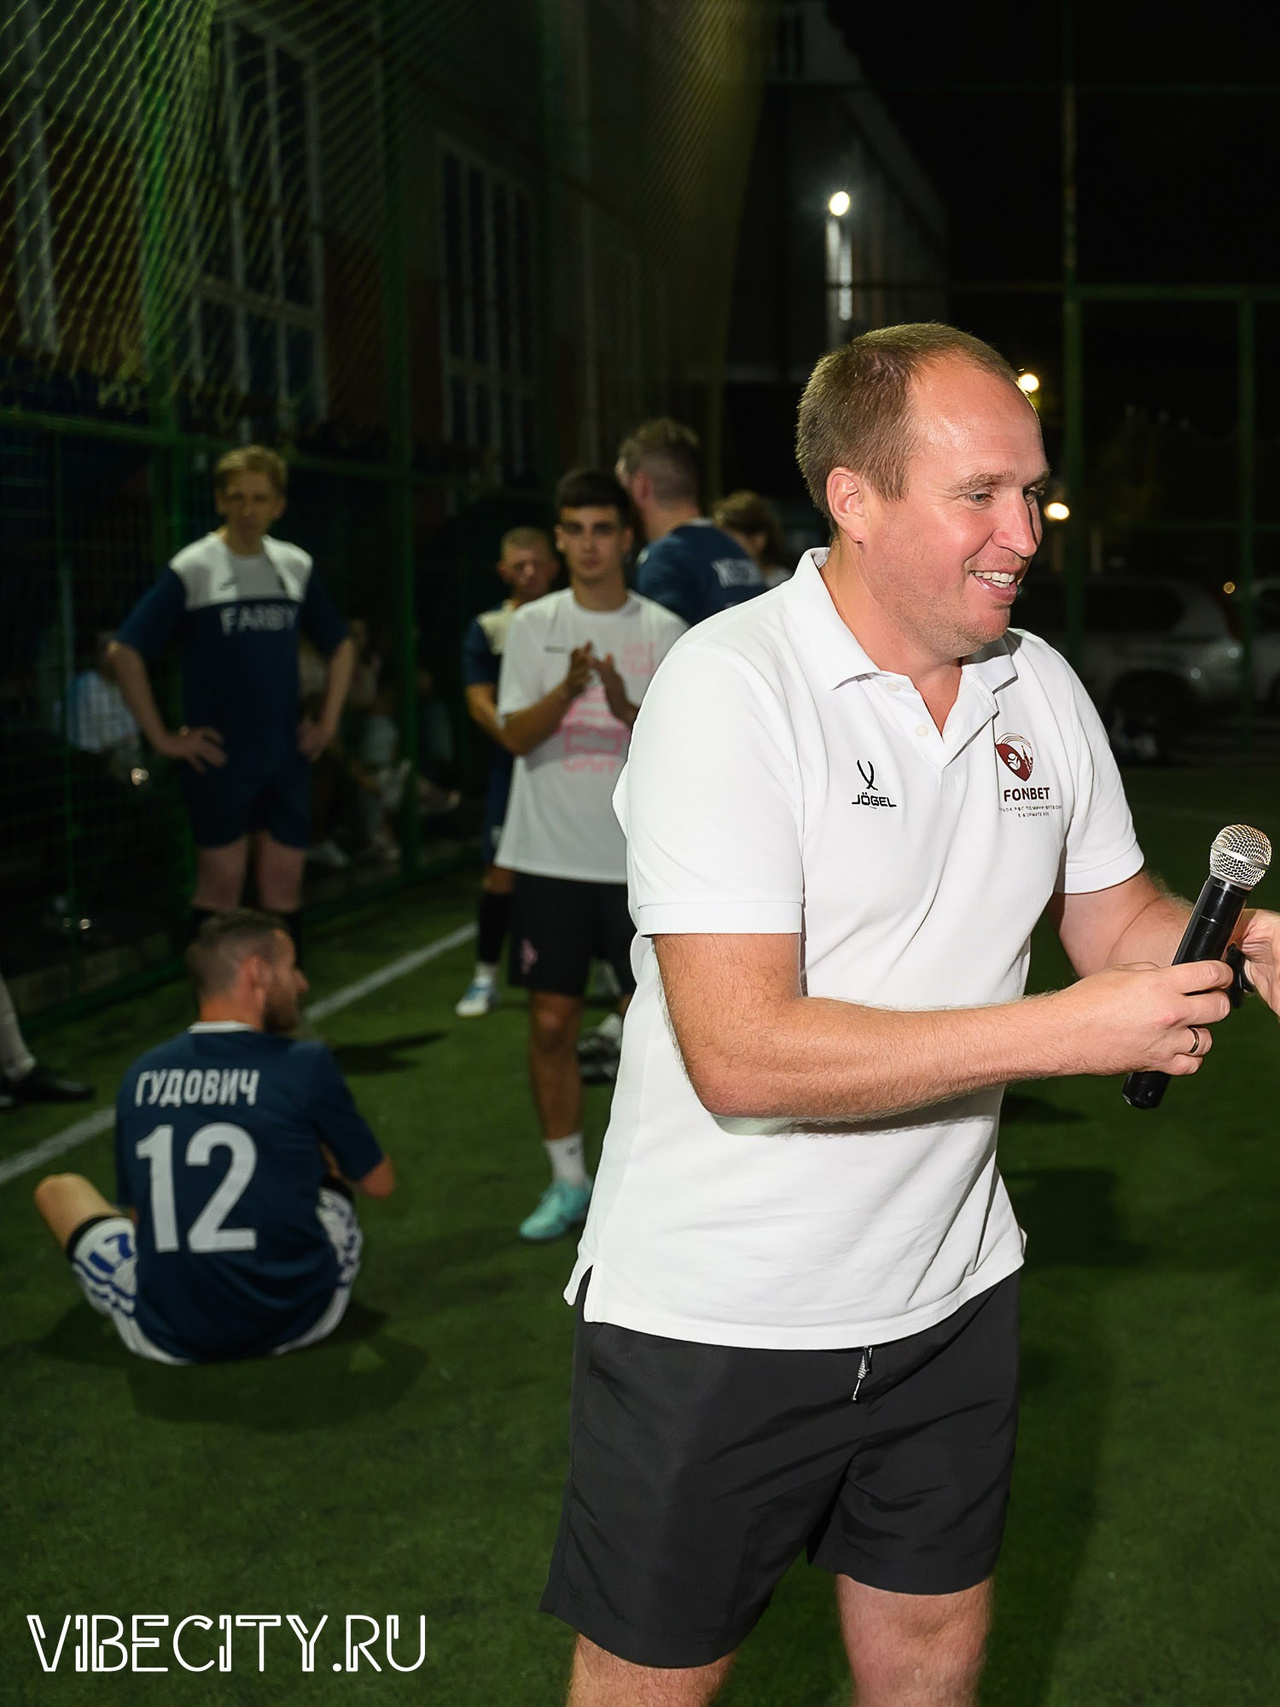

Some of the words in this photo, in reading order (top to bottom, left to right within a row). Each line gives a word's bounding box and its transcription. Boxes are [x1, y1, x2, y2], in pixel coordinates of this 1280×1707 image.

[851, 791, 897, 808] JÖGEL
[1003, 787, 1050, 802] FONBET
[135, 1069, 260, 1108] ГУДОВИЧ
[136, 1122, 257, 1253] 12
